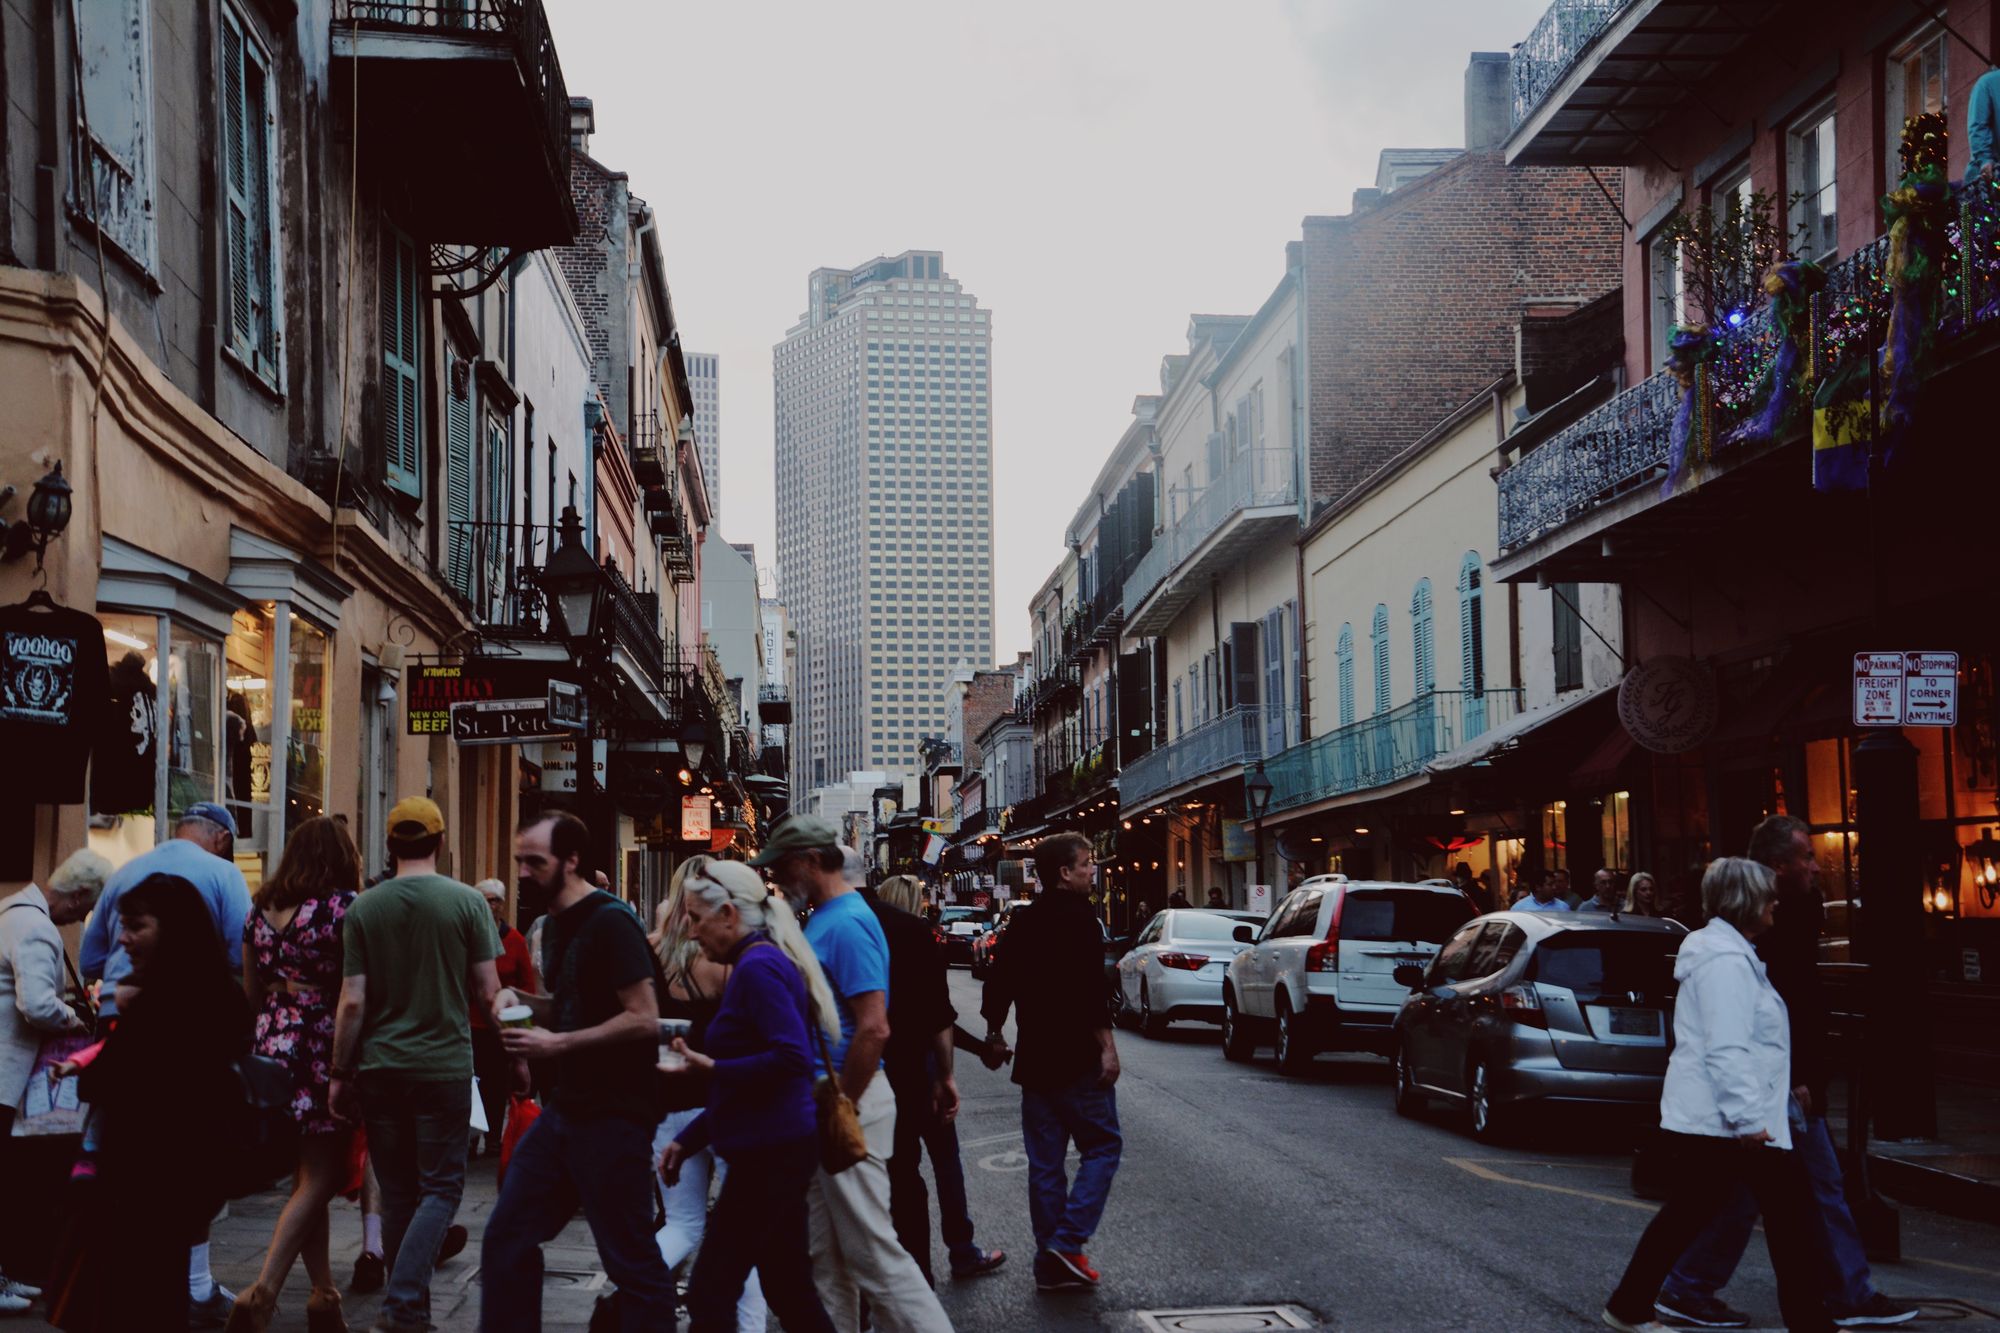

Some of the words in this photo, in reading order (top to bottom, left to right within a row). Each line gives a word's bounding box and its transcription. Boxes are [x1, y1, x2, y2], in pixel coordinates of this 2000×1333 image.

[8, 635, 72, 663] VOODOO
[766, 630, 774, 675] HOTEL
[1856, 659, 1870, 672] NO
[1870, 660, 1901, 670] PARKING
[1906, 658, 1920, 672] NO
[1920, 660, 1955, 670] STOPPING
[1859, 678, 1899, 689] FREIGHT
[1924, 678, 1937, 687] TO
[1865, 690, 1891, 700] ZONE
[1909, 689, 1951, 698] CORNER
[409, 711, 431, 719] NEW
[1908, 711, 1953, 721] ANYTIME
[412, 719, 449, 732] BEEF
[456, 716, 489, 735] St.
[501, 714, 550, 734] Pete
[543, 761, 604, 771] UNLIMED
[563, 779, 577, 788] 63
